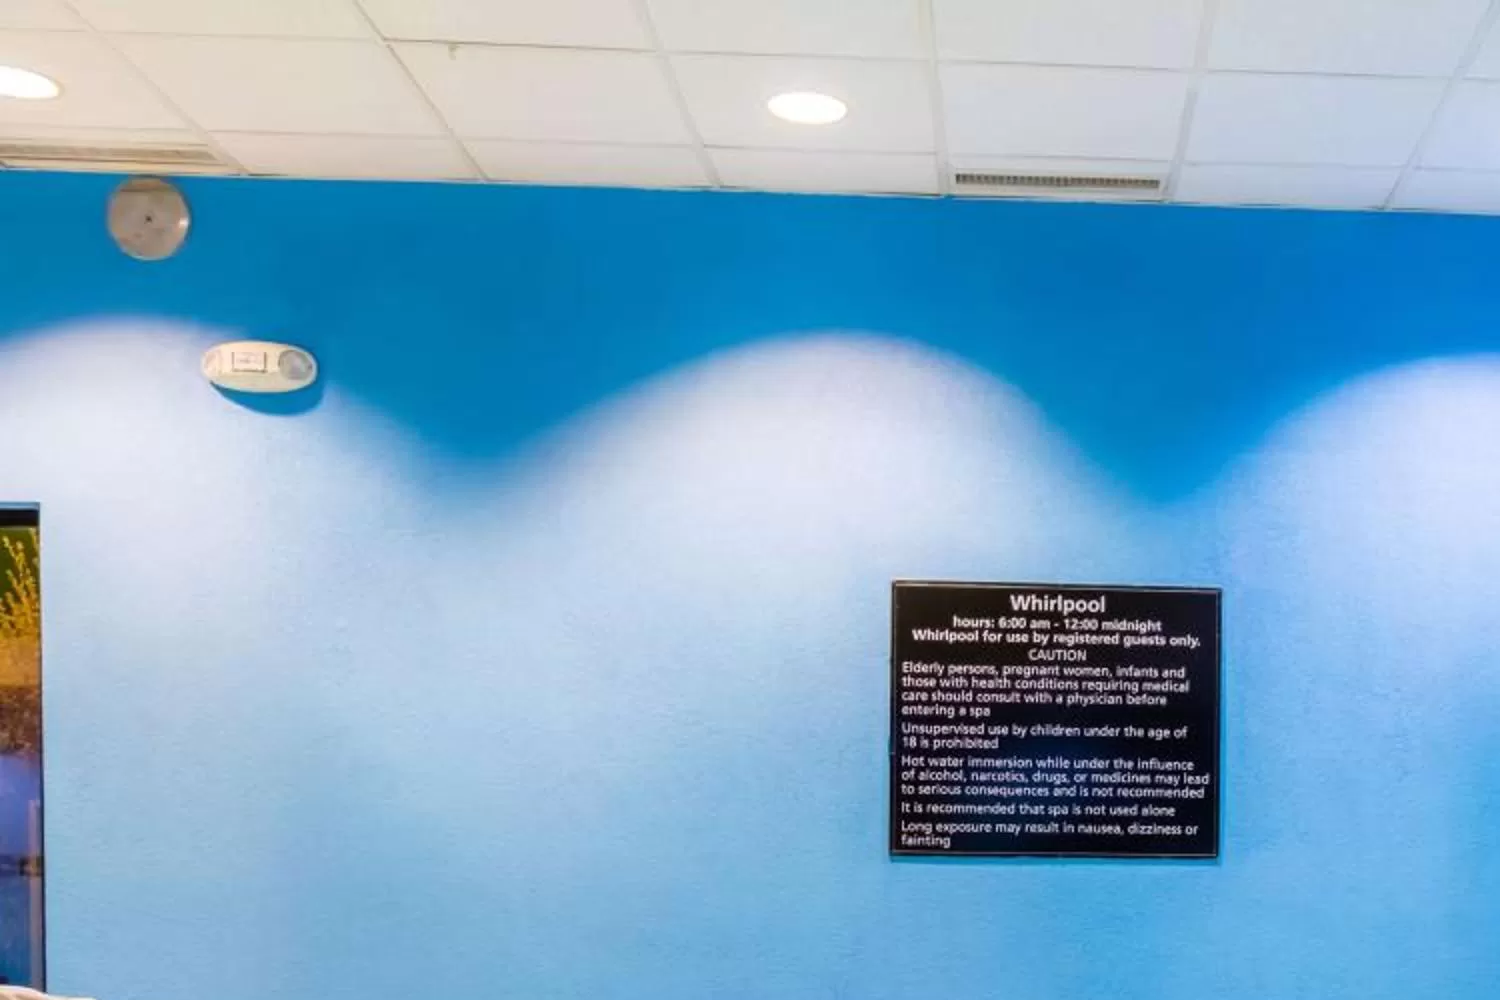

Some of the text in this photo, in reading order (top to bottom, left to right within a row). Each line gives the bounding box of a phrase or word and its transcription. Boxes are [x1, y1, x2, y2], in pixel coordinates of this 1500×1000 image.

[1009, 595, 1105, 615] Whirlpool
[1029, 620, 1051, 628] am
[1101, 618, 1162, 633] midnight
[911, 629, 979, 644] Whirlpool
[981, 631, 1003, 642] for
[1005, 634, 1029, 642] use
[1032, 632, 1050, 645] by
[1052, 632, 1120, 646] registered
[1123, 633, 1166, 647] guests
[1028, 648, 1086, 660] CAUTION
[902, 661, 945, 675] Elderly
[1002, 663, 1060, 677] pregnant
[1116, 665, 1159, 677] infants
[1161, 666, 1185, 677] and
[901, 676, 1189, 693] those with health conditions requiring medical
[901, 690, 1167, 706] care should consult with a physician before
[901, 704, 955, 718] entering
[969, 708, 990, 718] spa
[901, 722, 1187, 739] Unsupervised use by children under the age of
[903, 736, 998, 750] 18 is prohibited
[901, 754, 1194, 770] Hot water immersion while under the influence
[901, 769, 915, 780] of
[1073, 774, 1088, 782] or
[1091, 772, 1151, 784] medicines
[1154, 776, 1180, 786] may
[1183, 774, 1209, 785] lead
[901, 782, 1204, 798] to serious consequences and is not recommended
[901, 801, 1175, 817] It is recommended that spa is not used alone
[901, 819, 932, 833] Long
[935, 822, 992, 834] exposure
[995, 823, 1021, 835] may
[1025, 821, 1059, 833] result
[1063, 822, 1074, 833] in
[1127, 823, 1182, 835] dizziness
[1185, 827, 1198, 835] or
[901, 834, 950, 848] fainting
